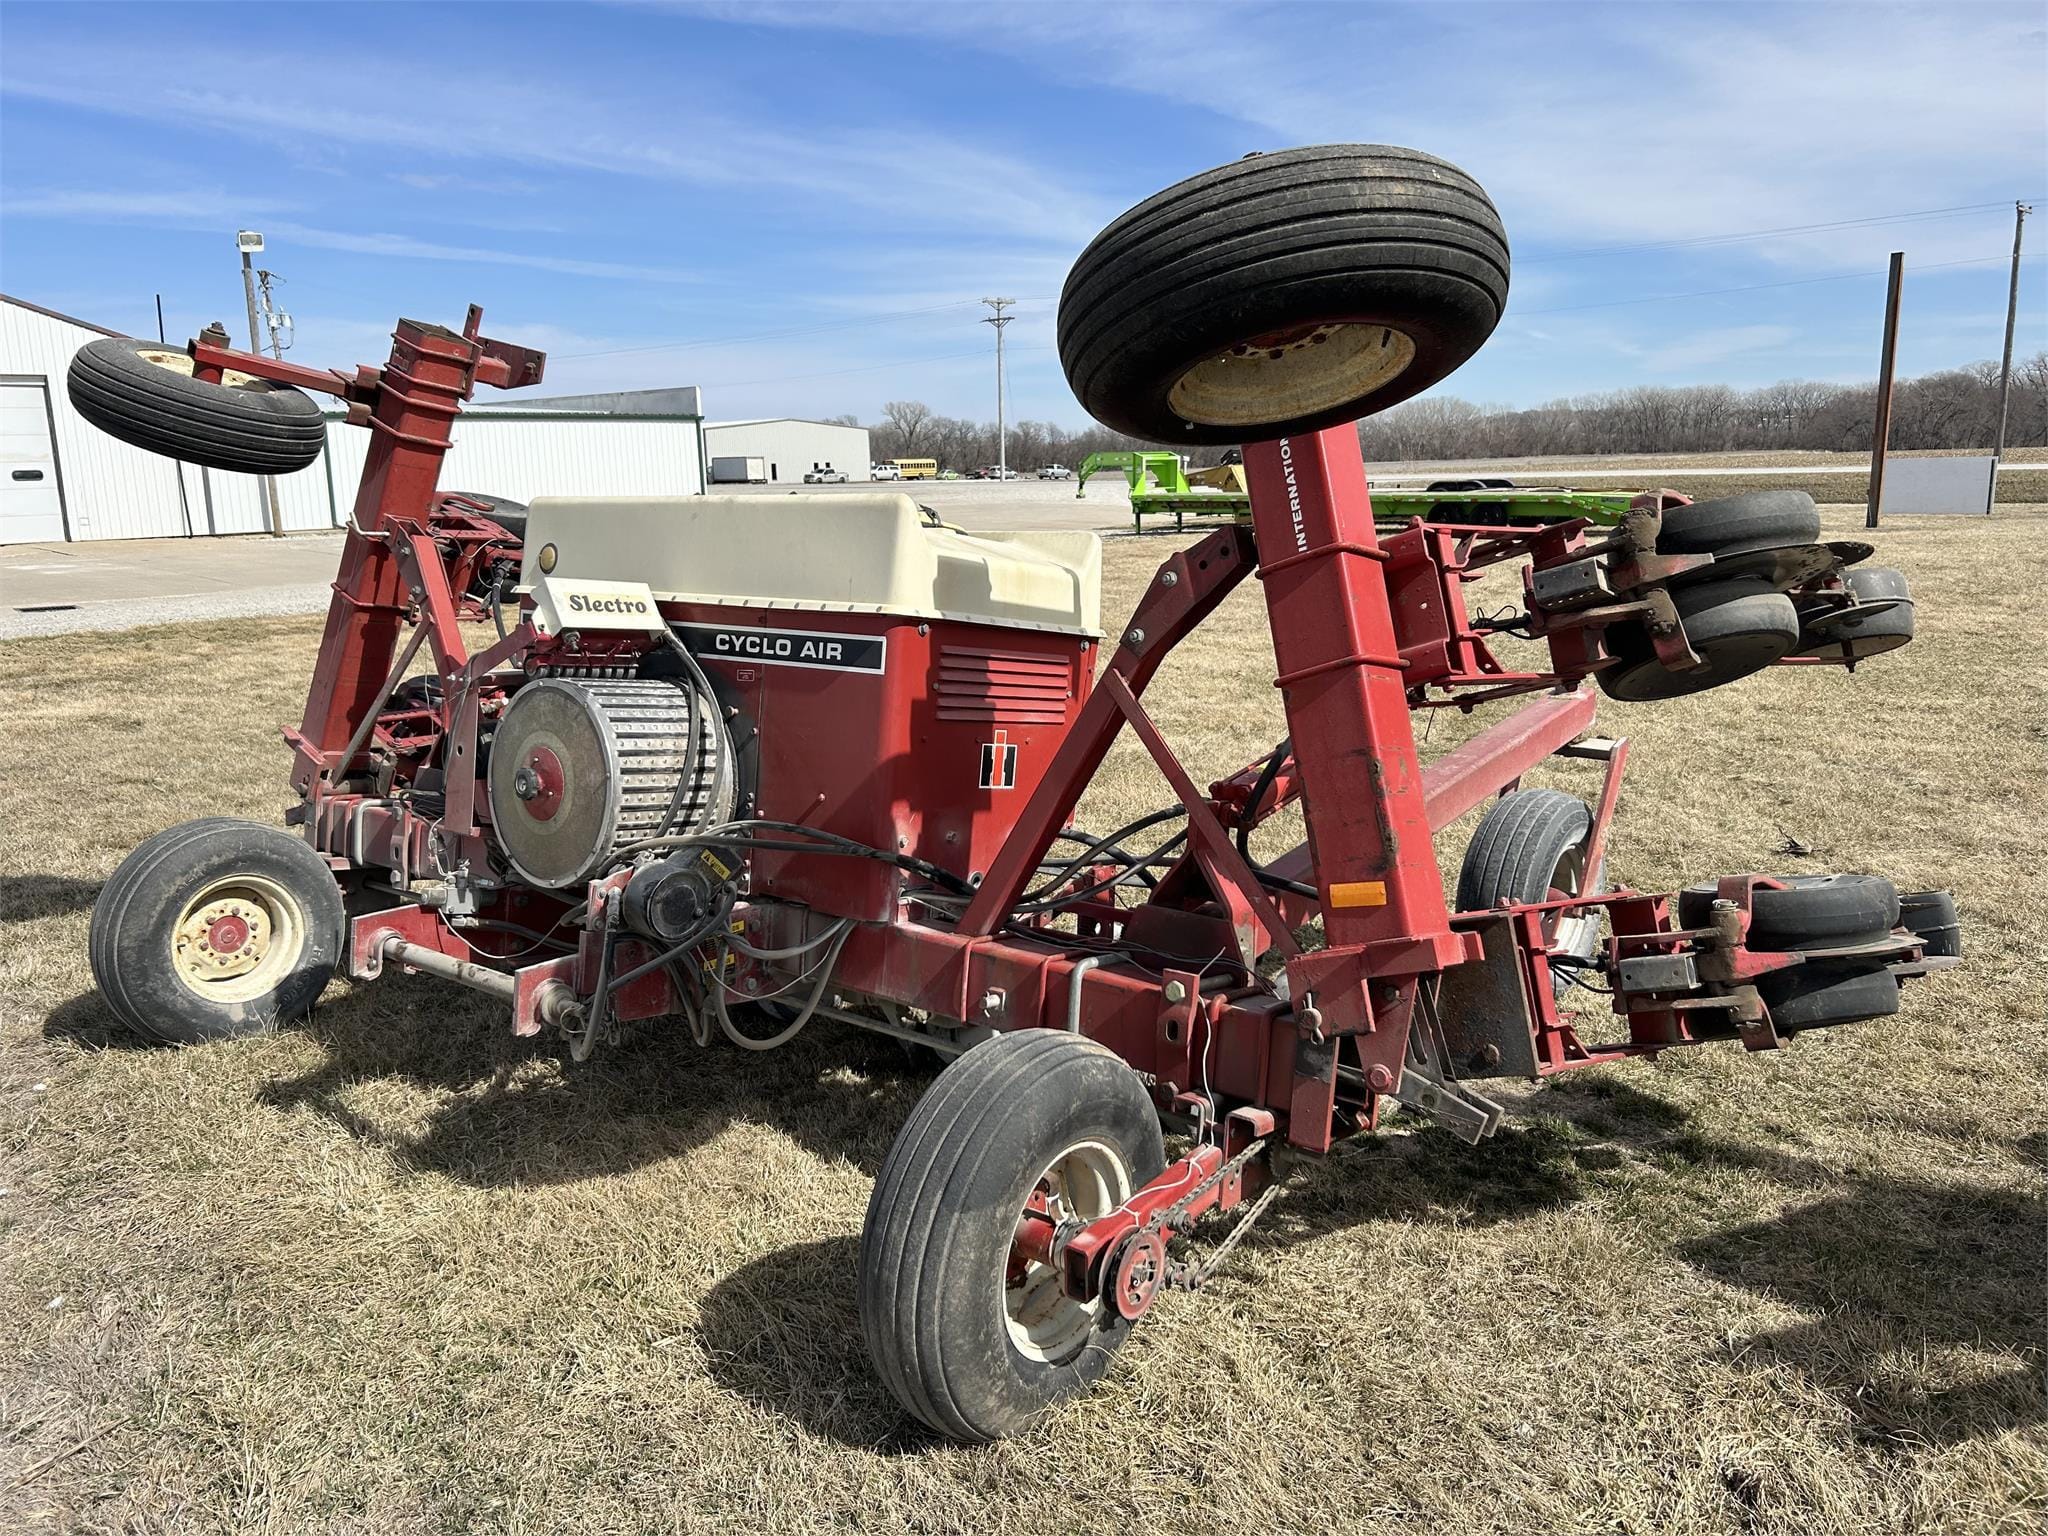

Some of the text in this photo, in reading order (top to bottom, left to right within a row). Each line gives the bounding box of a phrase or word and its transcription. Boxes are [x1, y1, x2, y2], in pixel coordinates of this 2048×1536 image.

[569, 594, 647, 613] Slectro
[715, 633, 843, 660] CYCLO AIR
